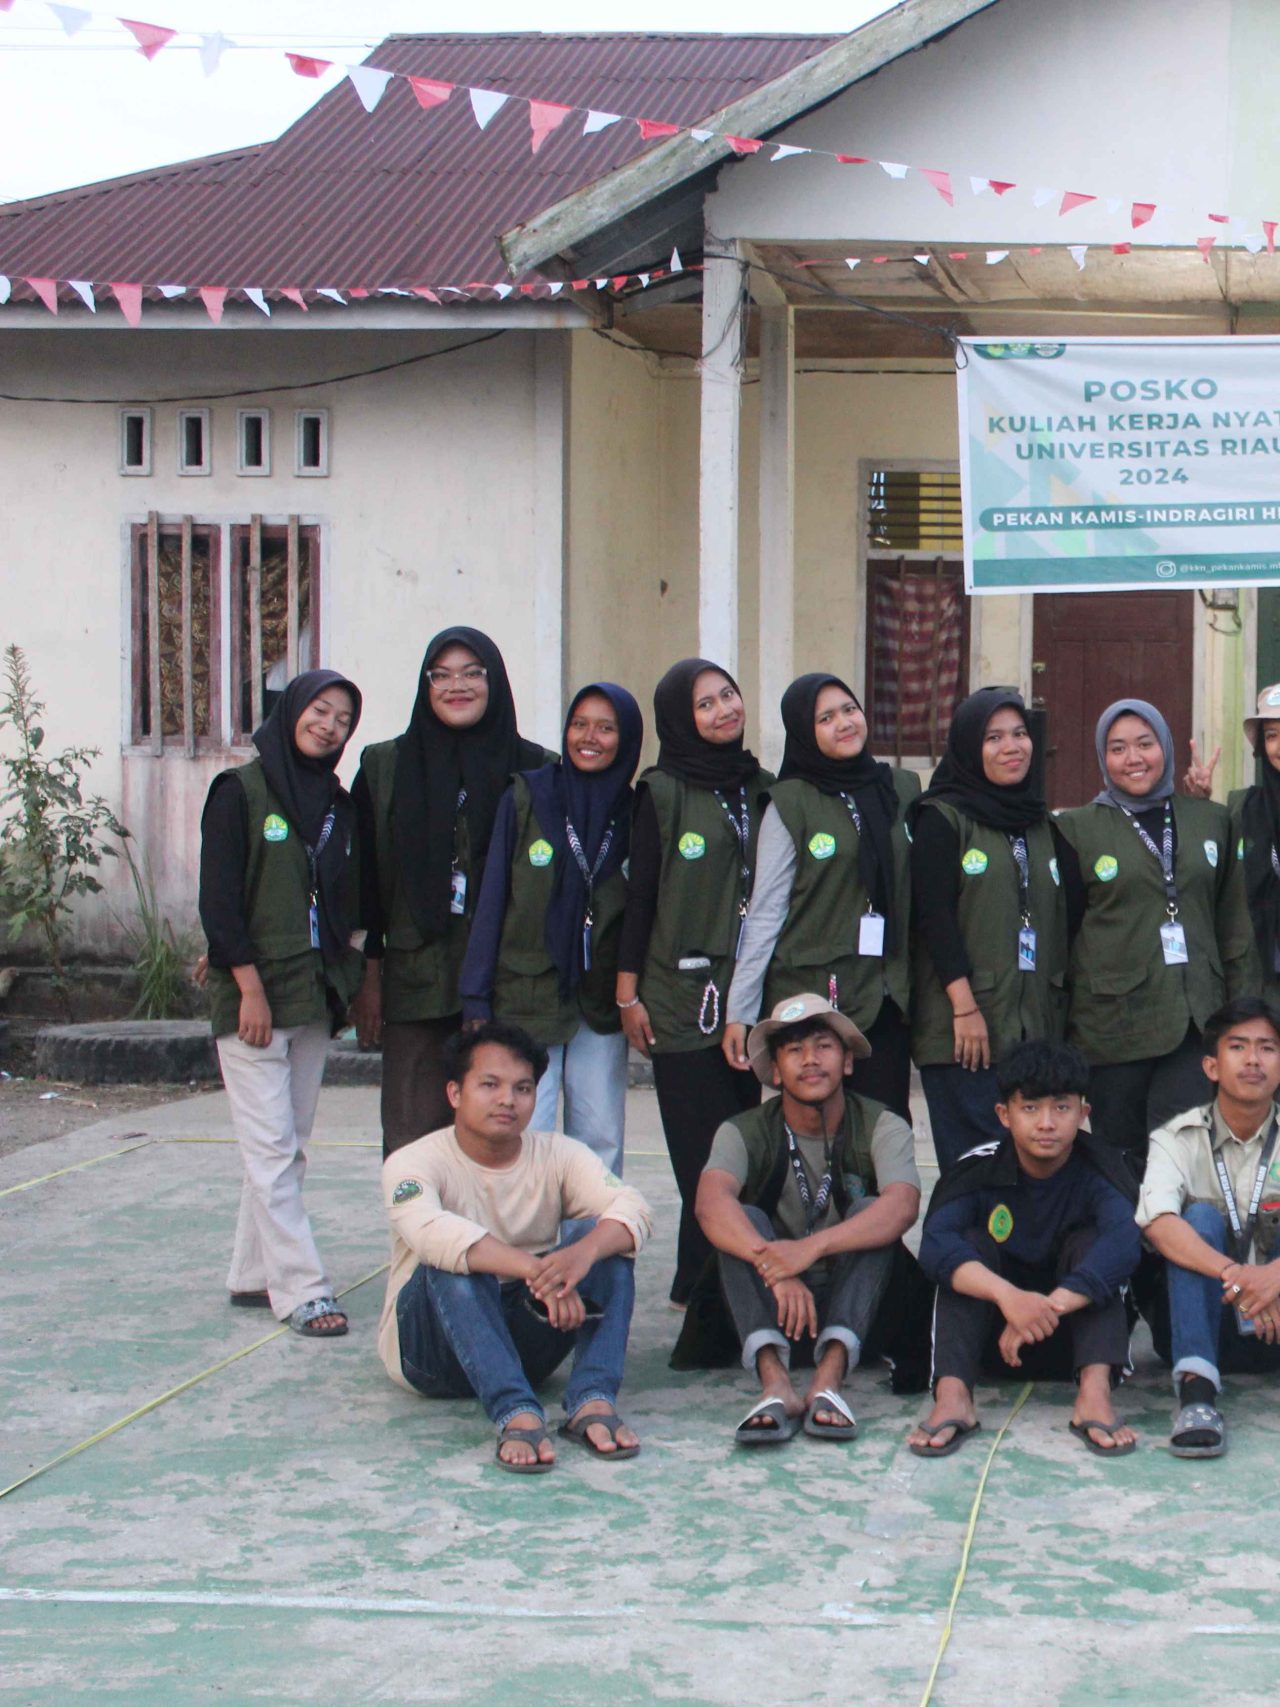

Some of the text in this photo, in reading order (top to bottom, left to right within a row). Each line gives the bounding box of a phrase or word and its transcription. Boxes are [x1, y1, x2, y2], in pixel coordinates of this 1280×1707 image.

[1084, 378, 1218, 402] POSKO
[988, 415, 1096, 434] KULIAH
[1108, 411, 1202, 431] KERJA
[1015, 439, 1210, 461] UNIVERSITAS
[1119, 467, 1189, 486] 2024
[993, 512, 1063, 527] PEKAN
[1071, 507, 1255, 526] KAMIS-INDRAGIRI
